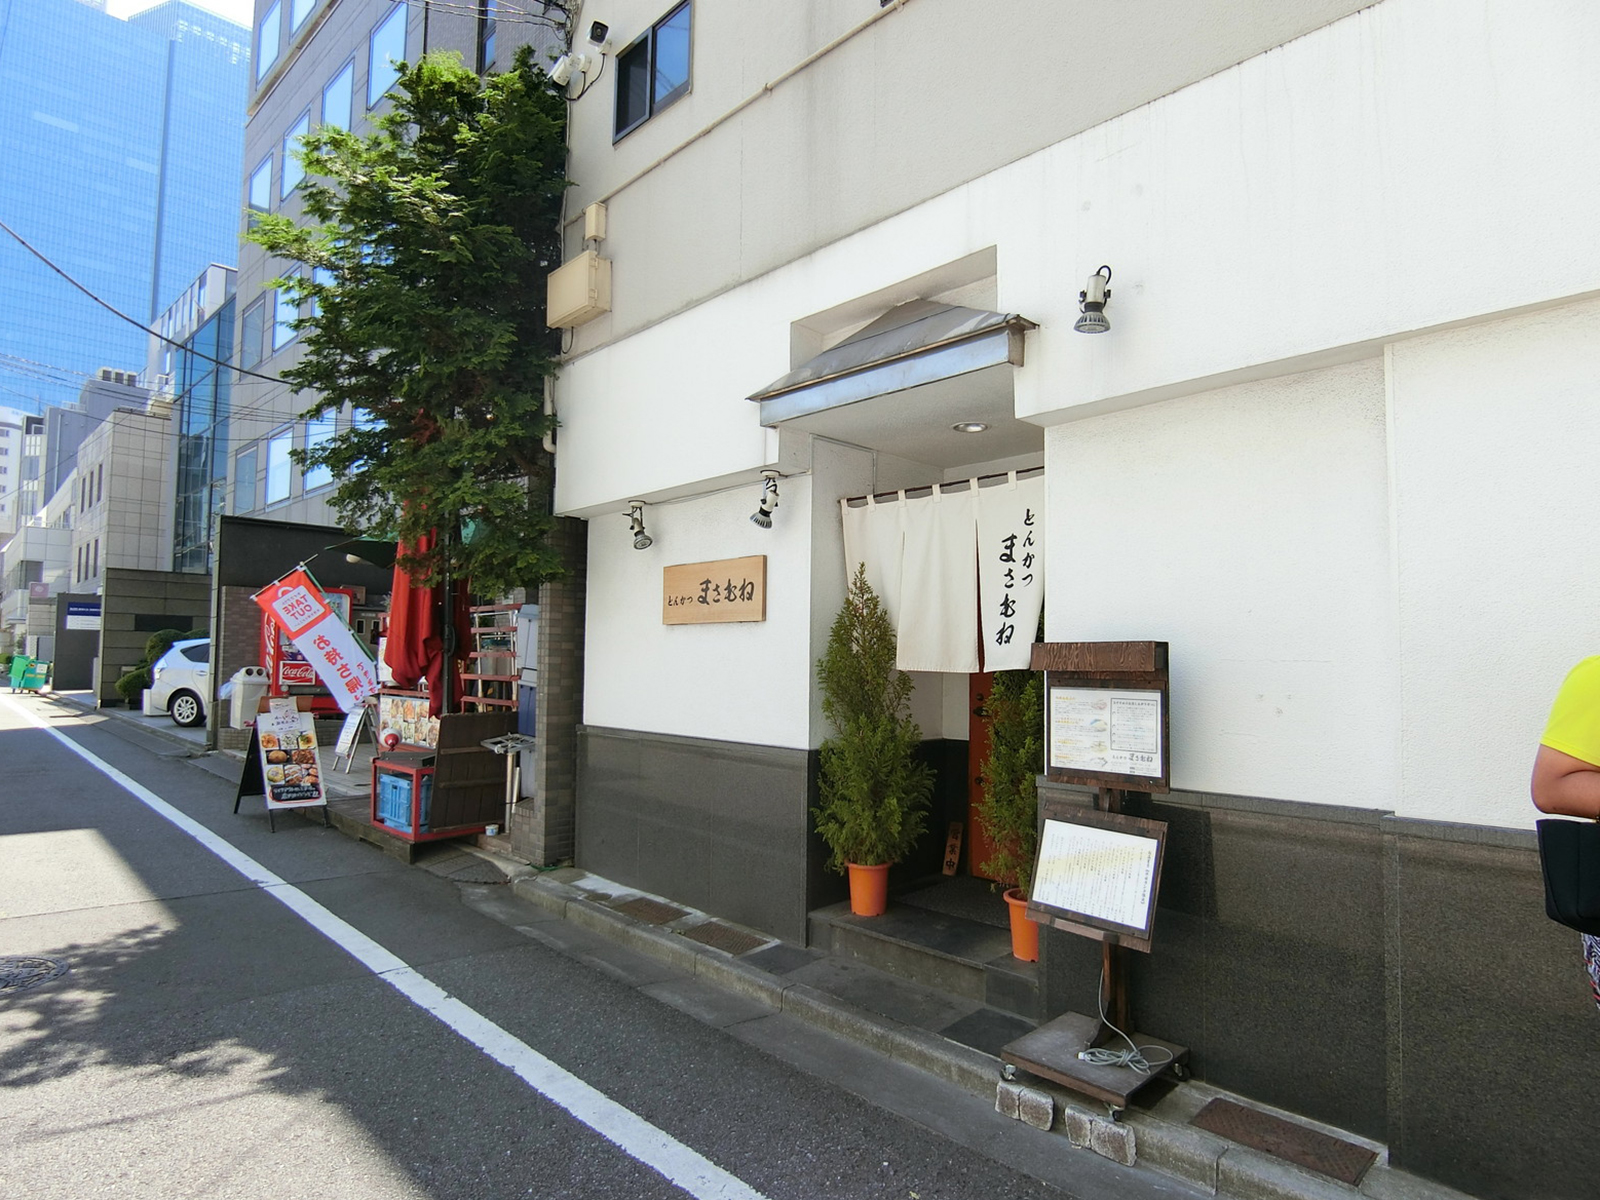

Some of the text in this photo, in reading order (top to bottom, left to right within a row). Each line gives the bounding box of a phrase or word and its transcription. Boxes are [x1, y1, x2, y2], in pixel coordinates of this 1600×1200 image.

[1022, 508, 1035, 587] とんかつ
[667, 578, 755, 606] とんかつ まさむね
[995, 533, 1018, 646] まさむね
